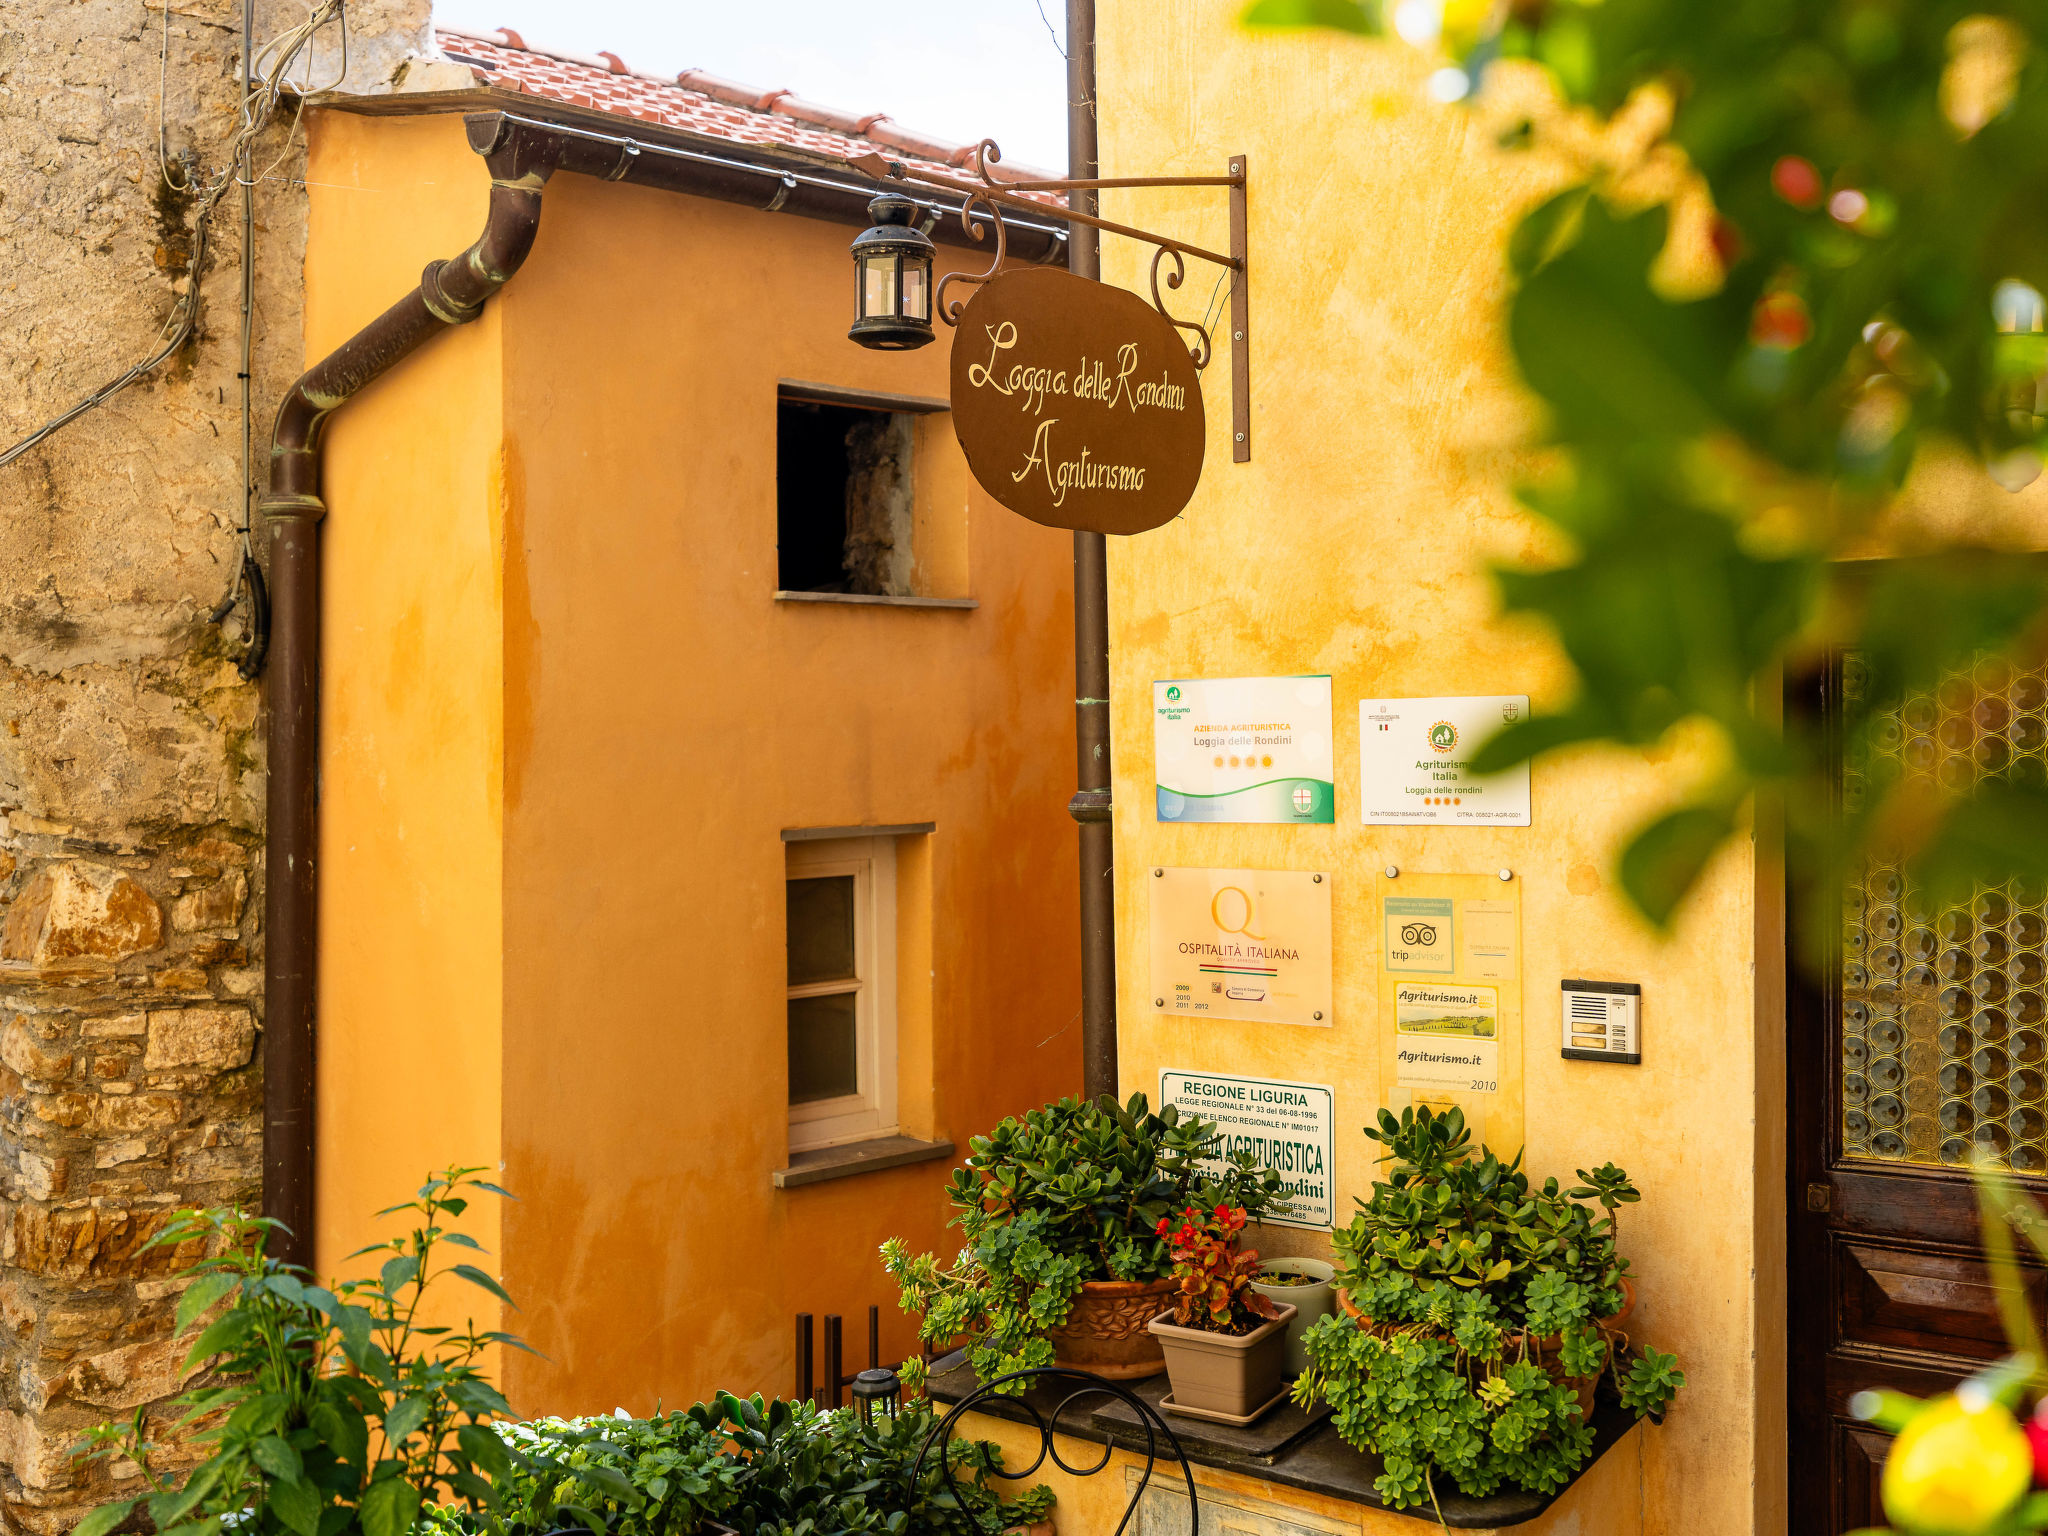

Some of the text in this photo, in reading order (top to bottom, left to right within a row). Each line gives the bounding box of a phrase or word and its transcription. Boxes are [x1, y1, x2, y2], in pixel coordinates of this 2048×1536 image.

[968, 321, 1186, 416] Loggia delle Rondini
[1012, 419, 1146, 507] Agriturismo
[1157, 707, 1191, 715] agriturismo
[1194, 723, 1291, 732] AZIENDA AGRITURISTICA
[1194, 735, 1292, 748] Loggia delle Rondini
[1415, 760, 1473, 771] Agriturism
[1432, 772, 1458, 781] Italia
[1405, 786, 1483, 795] Loggia delle rondini
[1211, 886, 1267, 941] Q
[1178, 942, 1300, 960] OSPITALITÀ ITALIANA
[1391, 949, 1445, 962] tripadvisor
[1398, 990, 1478, 1004] Agriturismo.it
[1397, 1050, 1482, 1066] Agriturismo.it
[1470, 1079, 1497, 1091] 2010
[1183, 1081, 1308, 1107] REGIONE LIGURIA
[1175, 1096, 1200, 1106] LEGGE
[1201, 1099, 1244, 1111] REGIONALE
[1256, 1105, 1265, 1113] 33
[1266, 1107, 1278, 1115] del
[1278, 1108, 1318, 1120] 06-08-1996
[1176, 1109, 1208, 1120] CRIZIONE
[1209, 1113, 1238, 1124] ELENCO
[1239, 1116, 1280, 1129] REGIONALE
[1291, 1123, 1319, 1133] IM01017
[1225, 1134, 1324, 1175] AGRITURISTICA
[1276, 1178, 1324, 1199] ondini
[1276, 1200, 1312, 1212] CIPRESSA
[1313, 1207, 1327, 1215] (IM)
